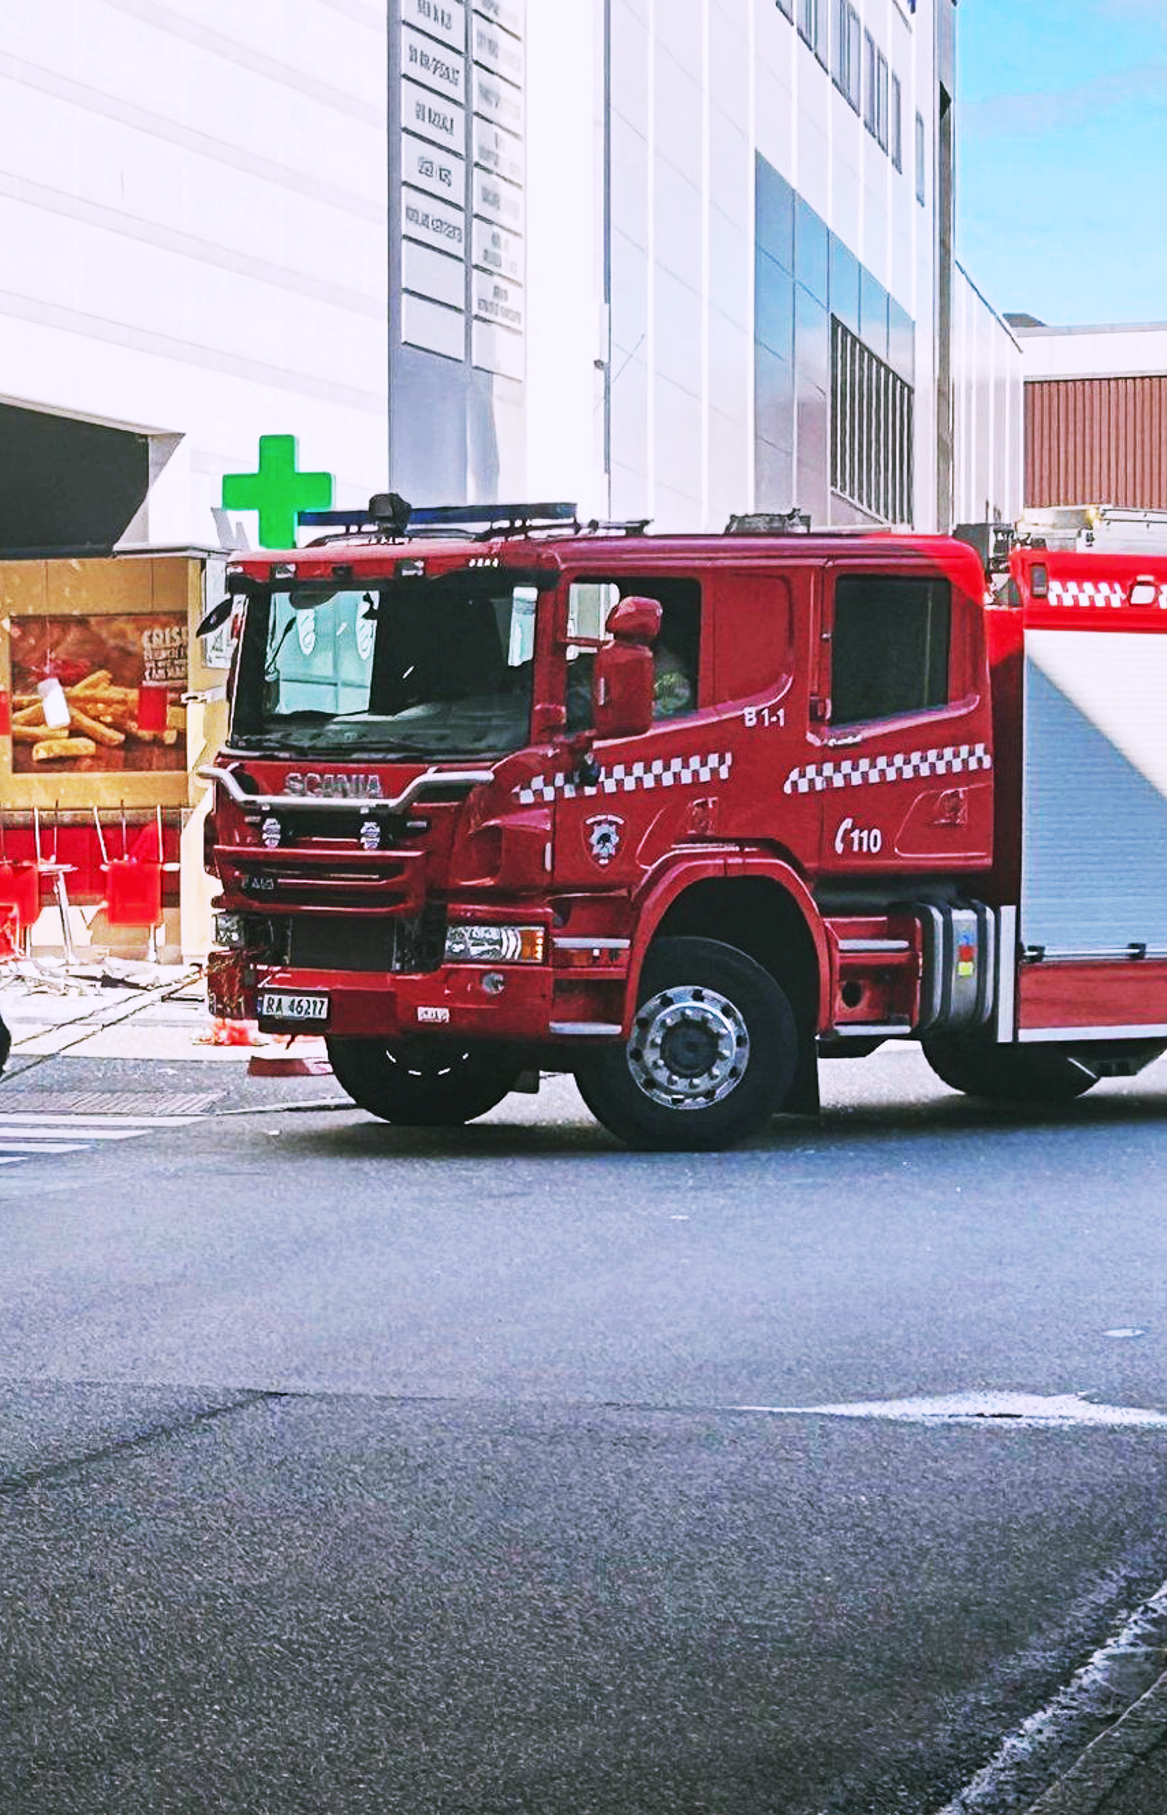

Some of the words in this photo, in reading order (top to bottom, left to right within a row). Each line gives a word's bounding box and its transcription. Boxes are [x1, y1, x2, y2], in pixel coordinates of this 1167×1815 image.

[284, 772, 384, 799] SCANIA
[850, 828, 882, 853] 110
[266, 996, 284, 1014] RA
